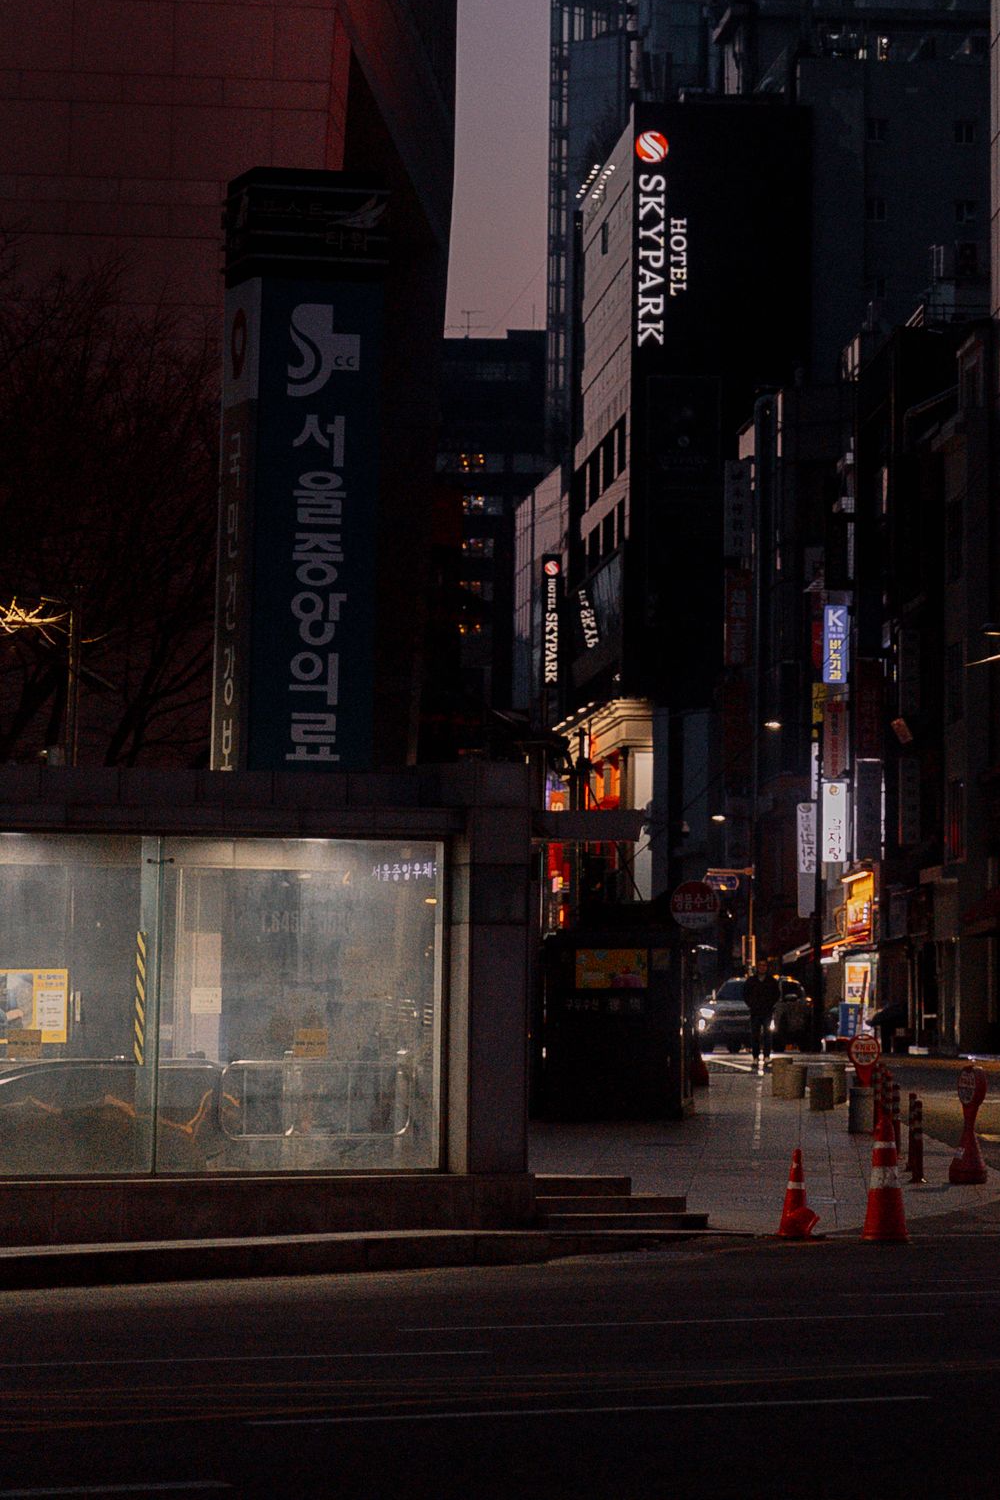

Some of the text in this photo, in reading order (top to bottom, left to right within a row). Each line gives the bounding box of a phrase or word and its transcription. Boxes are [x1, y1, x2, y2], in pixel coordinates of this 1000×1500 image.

[637, 174, 666, 347] SKYPARK
[670, 217, 687, 296] HOTEL
[284, 413, 350, 763] 서울중앙의료
[547, 578, 557, 611] HOTEL
[828, 609, 844, 627] K
[544, 612, 559, 683] SKYPARK
